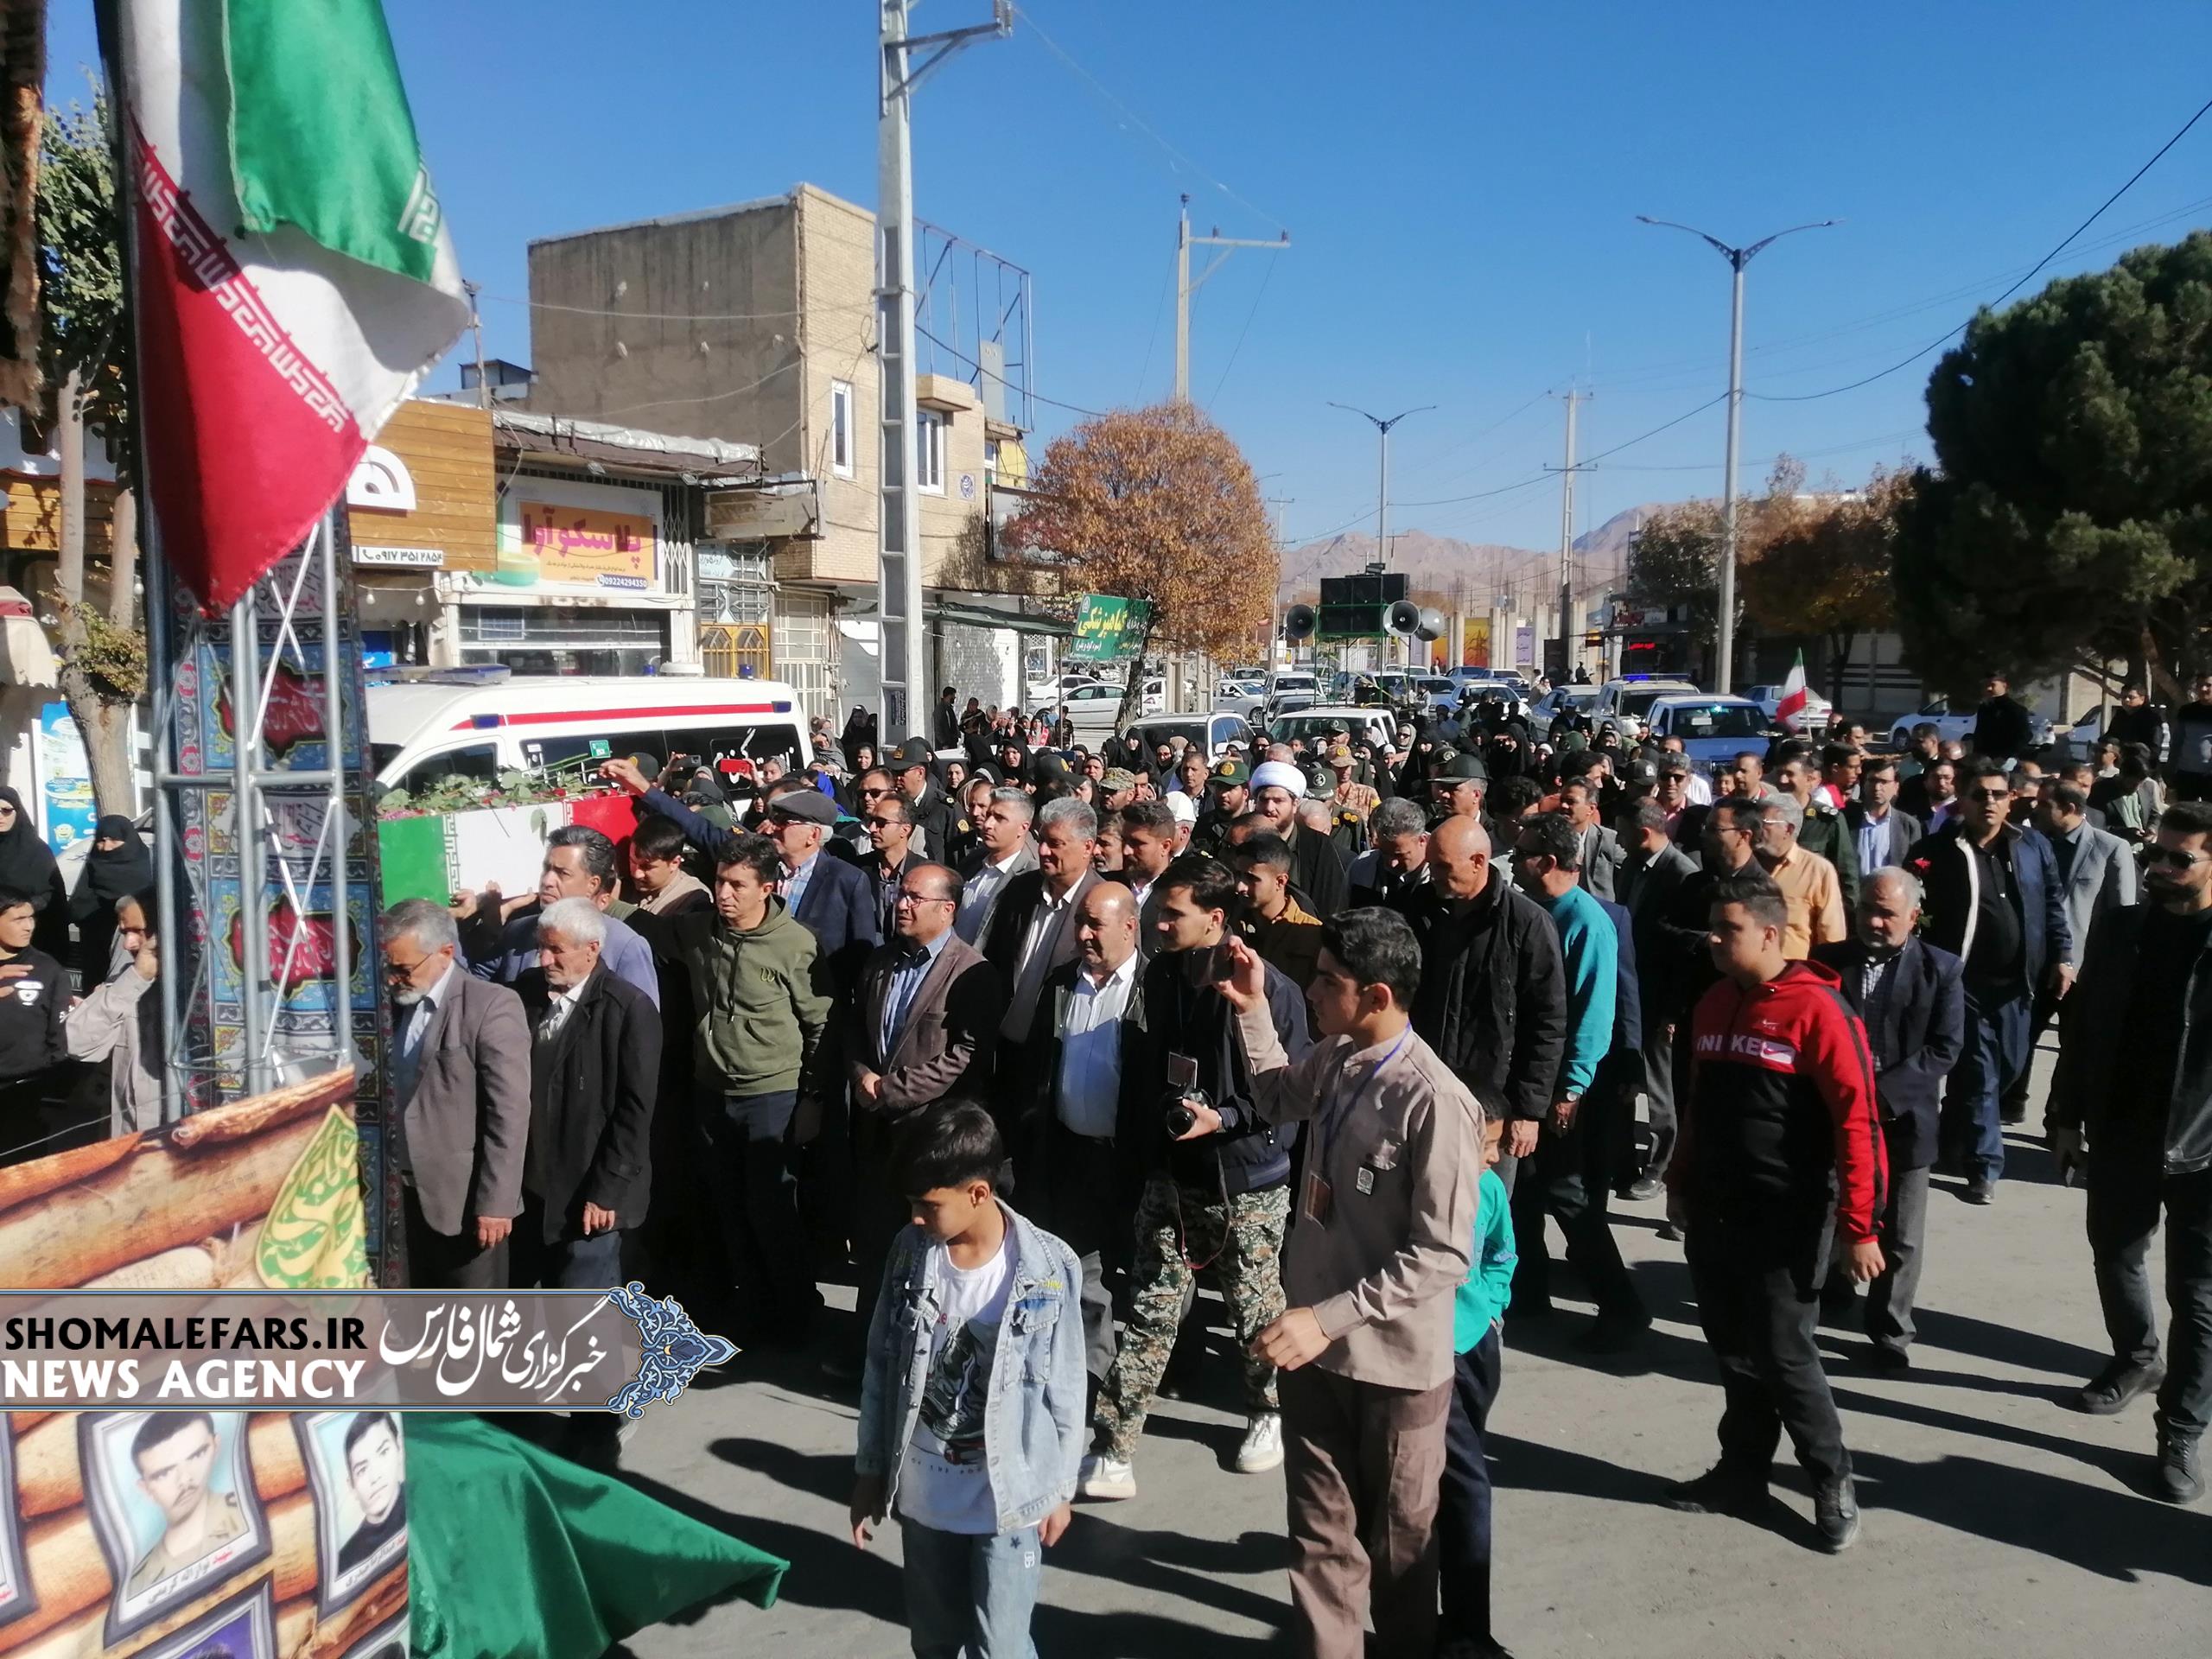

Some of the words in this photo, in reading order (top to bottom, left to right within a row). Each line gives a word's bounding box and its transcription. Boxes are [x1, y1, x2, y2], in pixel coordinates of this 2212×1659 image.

[524, 506, 555, 556] آوا
[558, 518, 641, 570] پلاسکو
[605, 577, 647, 588] 09224294350
